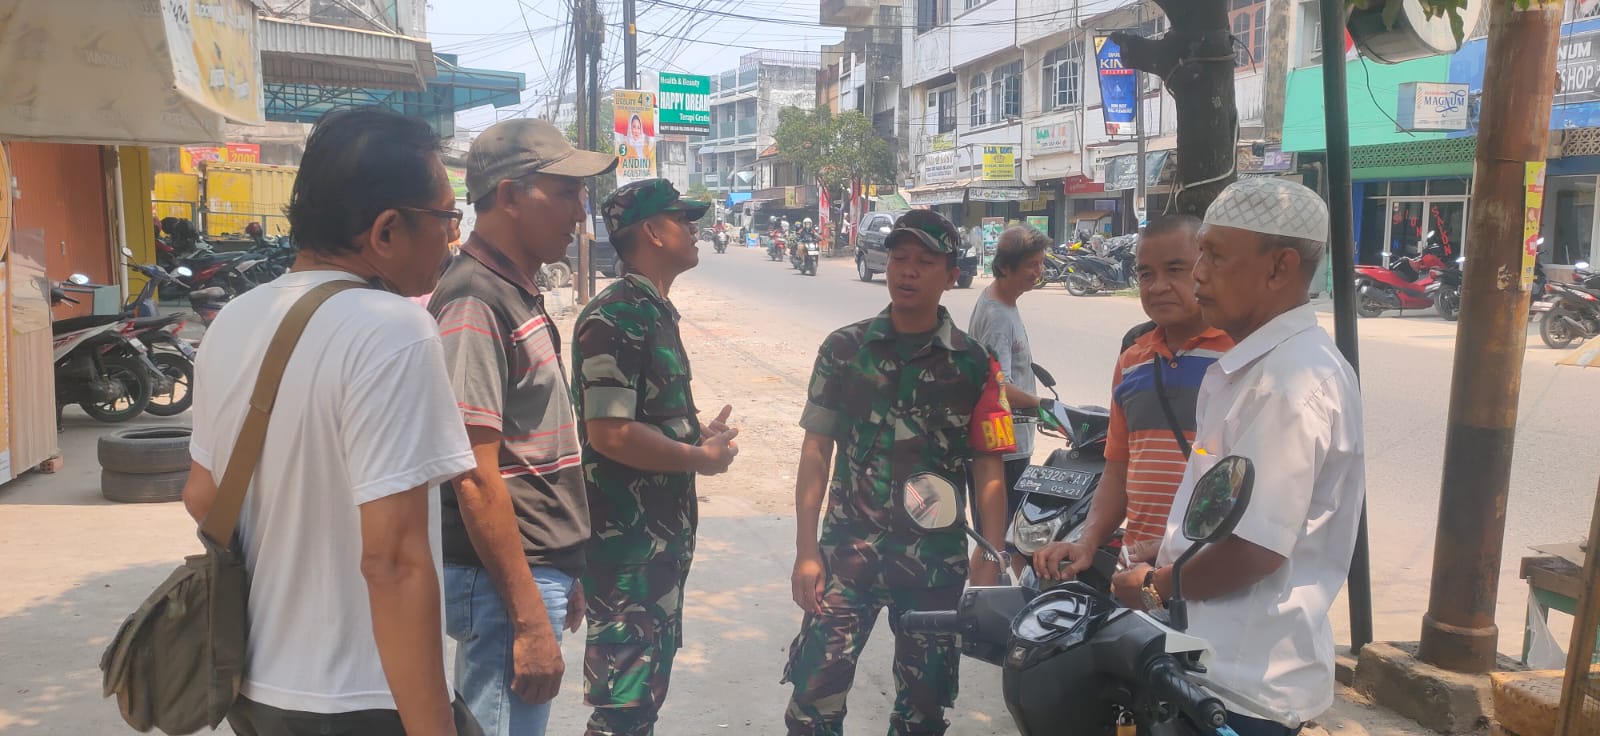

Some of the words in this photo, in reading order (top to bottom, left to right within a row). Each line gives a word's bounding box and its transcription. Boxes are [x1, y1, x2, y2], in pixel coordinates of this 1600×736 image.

[1557, 41, 1592, 61] NUM
[1100, 58, 1124, 69] KIN
[660, 76, 678, 85] Health
[683, 78, 700, 88] Beauty
[660, 91, 684, 110] HAPPY
[685, 93, 710, 112] DREAM
[620, 146, 626, 156] 3
[622, 158, 651, 169] ANDINI
